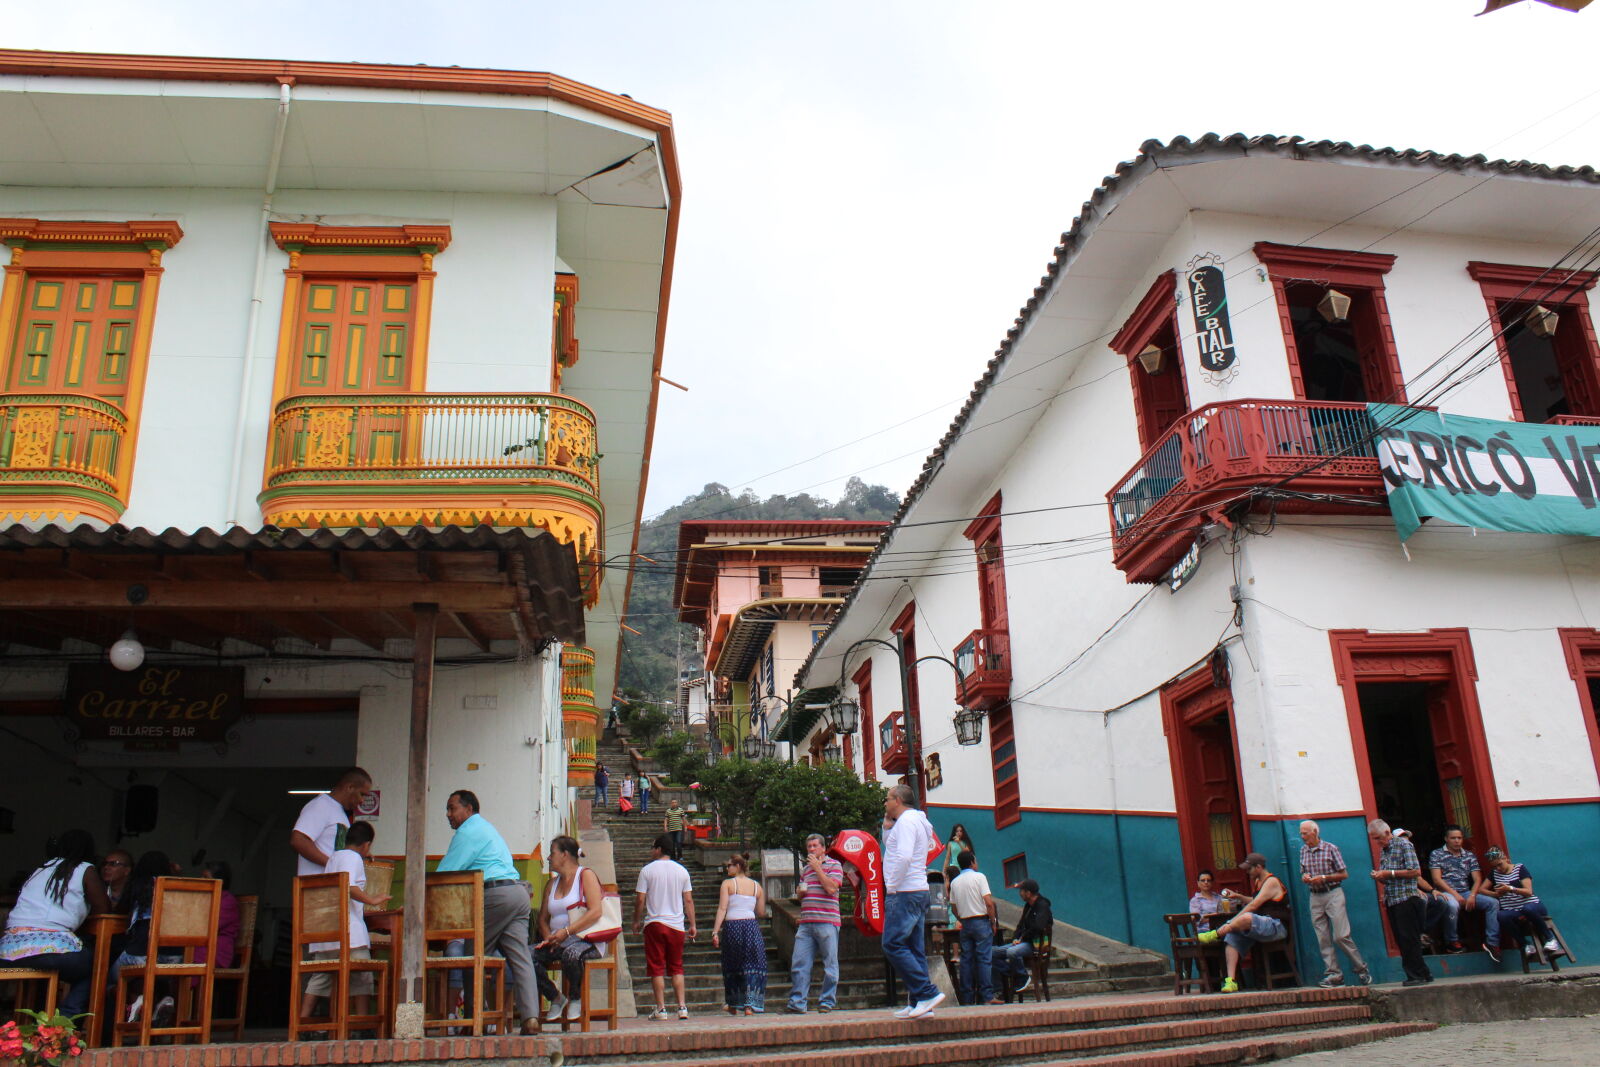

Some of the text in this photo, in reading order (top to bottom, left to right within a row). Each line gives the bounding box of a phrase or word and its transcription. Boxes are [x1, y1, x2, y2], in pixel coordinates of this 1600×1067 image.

[1190, 270, 1212, 317] CAFÉ
[138, 667, 181, 696] El
[78, 690, 229, 720] Carriel
[109, 726, 164, 737] BILLARES
[172, 726, 196, 737] BAR
[870, 888, 880, 919] EDATEL
